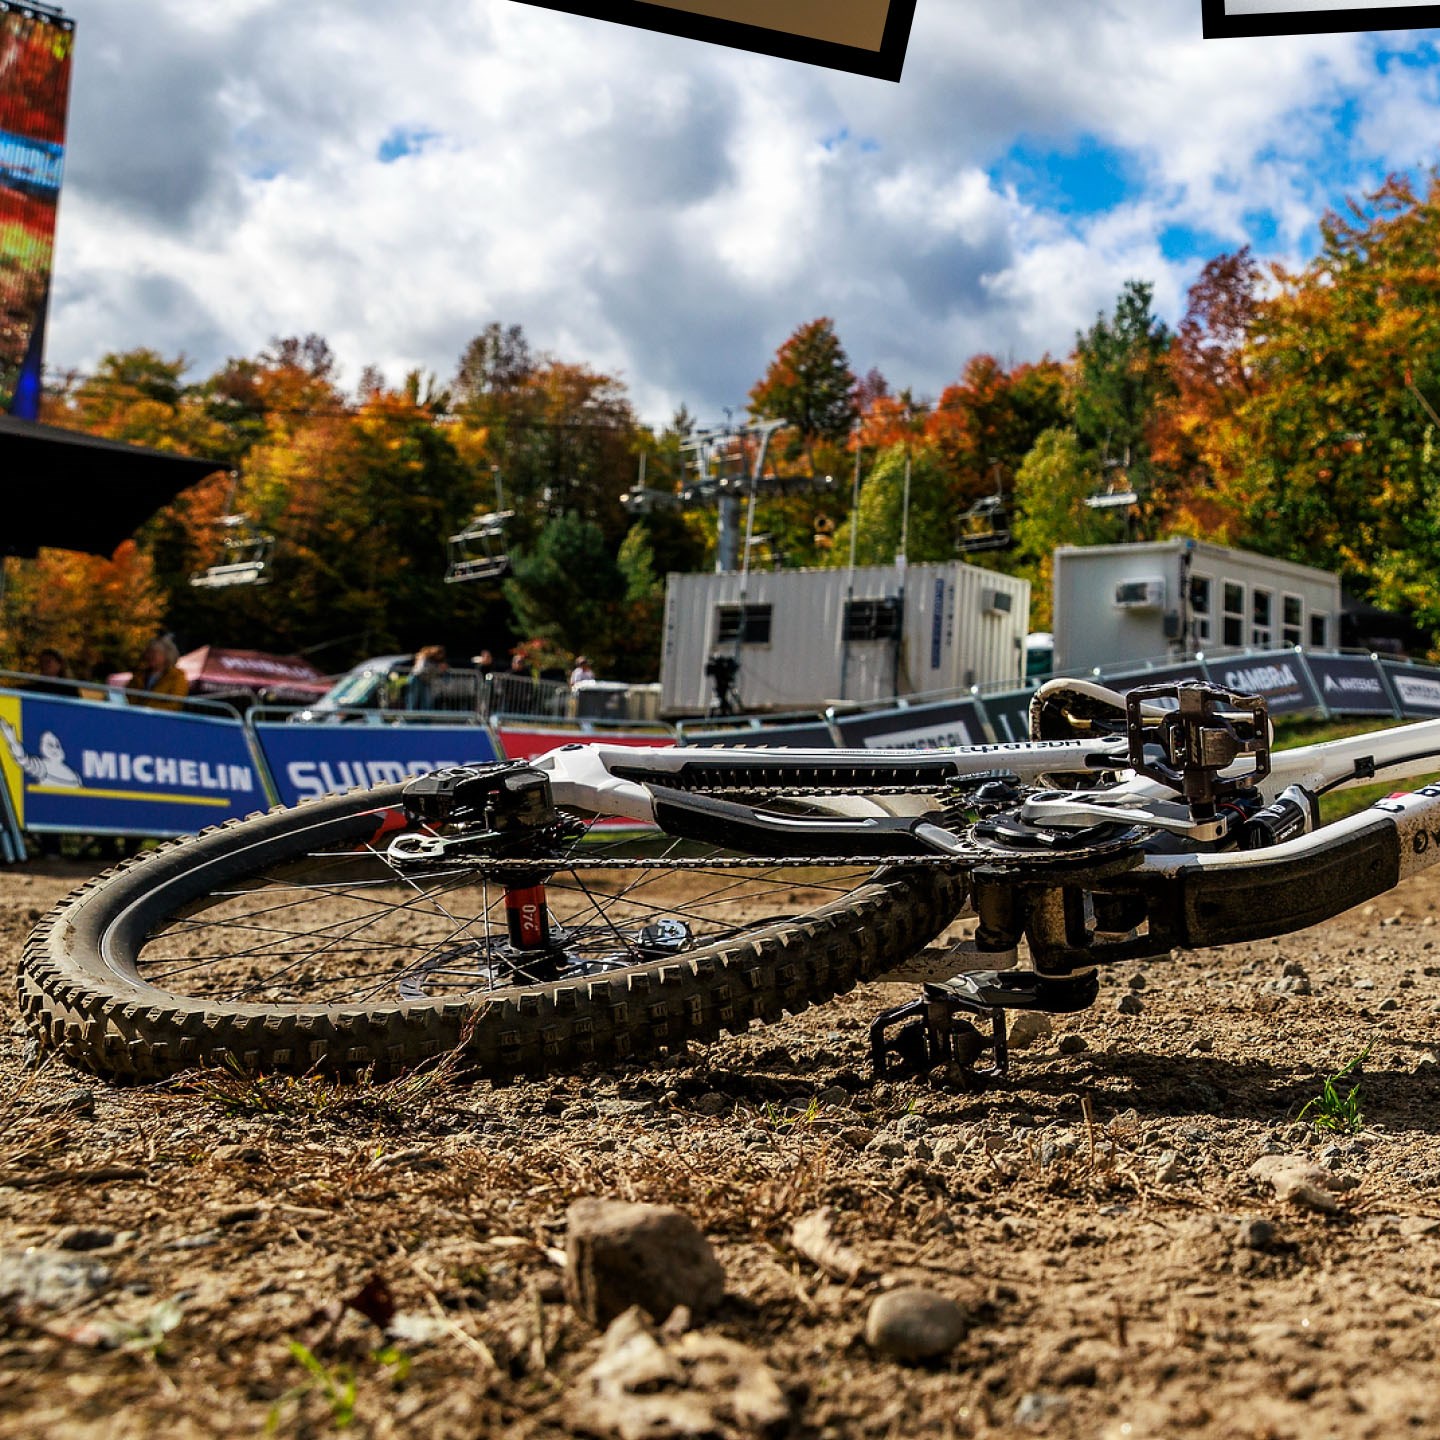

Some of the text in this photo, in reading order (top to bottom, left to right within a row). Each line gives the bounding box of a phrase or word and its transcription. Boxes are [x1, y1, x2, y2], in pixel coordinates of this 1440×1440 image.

[1225, 663, 1298, 692] CAMBRIA
[82, 750, 253, 792] MICHELIN
[522, 904, 537, 930] 240
